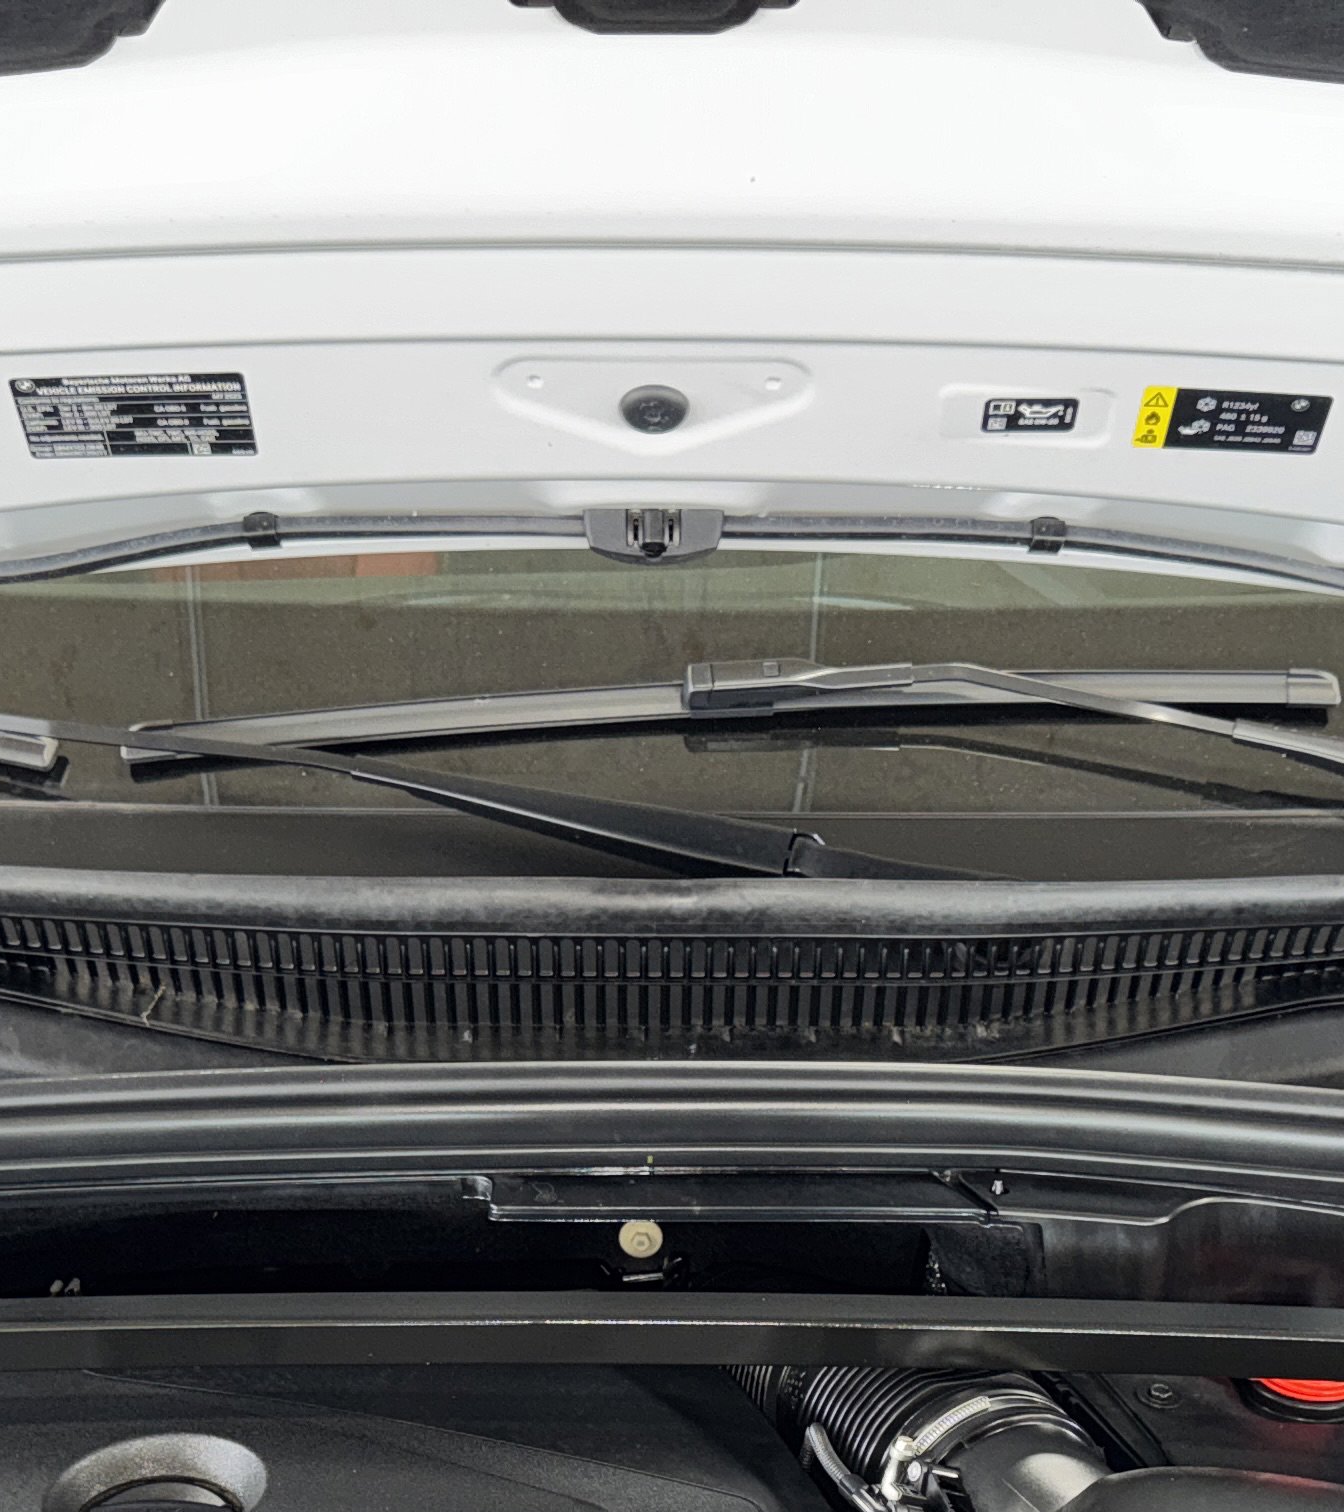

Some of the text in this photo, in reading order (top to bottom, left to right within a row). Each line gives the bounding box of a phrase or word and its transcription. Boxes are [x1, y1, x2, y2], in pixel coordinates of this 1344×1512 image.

[148, 375, 177, 383] Werke
[36, 381, 242, 396] VEHICLE EMISSION CONTROL INFORMATION
